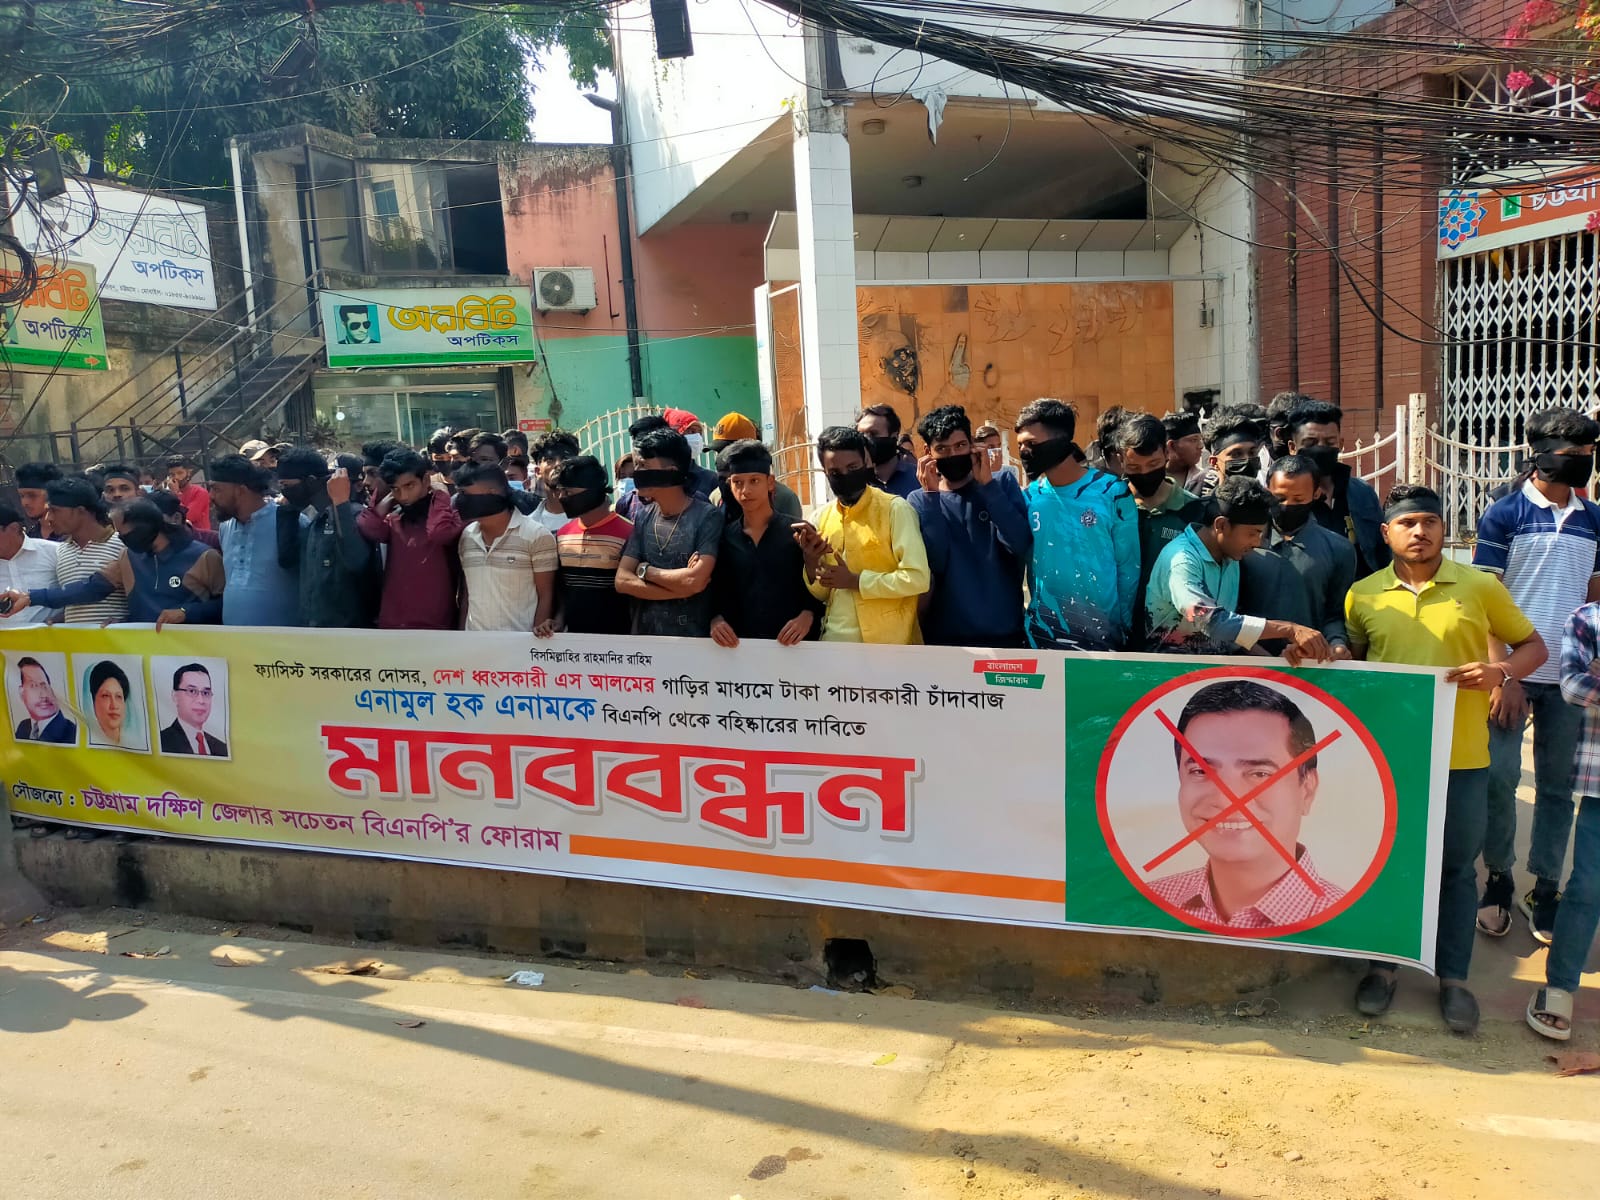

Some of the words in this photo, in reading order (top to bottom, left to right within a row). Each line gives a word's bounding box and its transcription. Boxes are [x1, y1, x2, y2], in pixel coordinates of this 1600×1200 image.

[1527, 178, 1600, 211] চট্টগ্রা
[583, 651, 623, 665] রাহমানির
[626, 652, 652, 666] রাহিম
[254, 660, 306, 679] ফ্যাসিস্ট
[310, 665, 372, 683] সরকারের
[377, 668, 427, 688] দোসর,
[433, 668, 465, 686] দেশ
[472, 666, 547, 690] ধ্বংসকারী
[554, 673, 582, 690] এস
[588, 673, 656, 693] আলমের
[715, 680, 773, 700] মাধ্যমে
[778, 680, 820, 702] টাকা
[827, 684, 919, 707] পাচারকারী
[926, 684, 1005, 709] চাঁদাবাজ
[354, 688, 437, 720] এনামুল
[443, 692, 485, 718] হক
[495, 693, 596, 723] এনামকে
[602, 704, 661, 727] বিএনপি
[669, 712, 711, 729] থেকে
[717, 710, 799, 735] বহিষ্কারের
[805, 715, 867, 737] দাবিতে
[321, 725, 917, 841] মানববন্ধন
[81, 784, 141, 815] চট্টগ্রাম
[146, 792, 204, 819] দক্ষিণ
[212, 802, 273, 827] জেলার
[279, 809, 355, 834] সচেতন
[481, 824, 562, 852] ফোরাম
